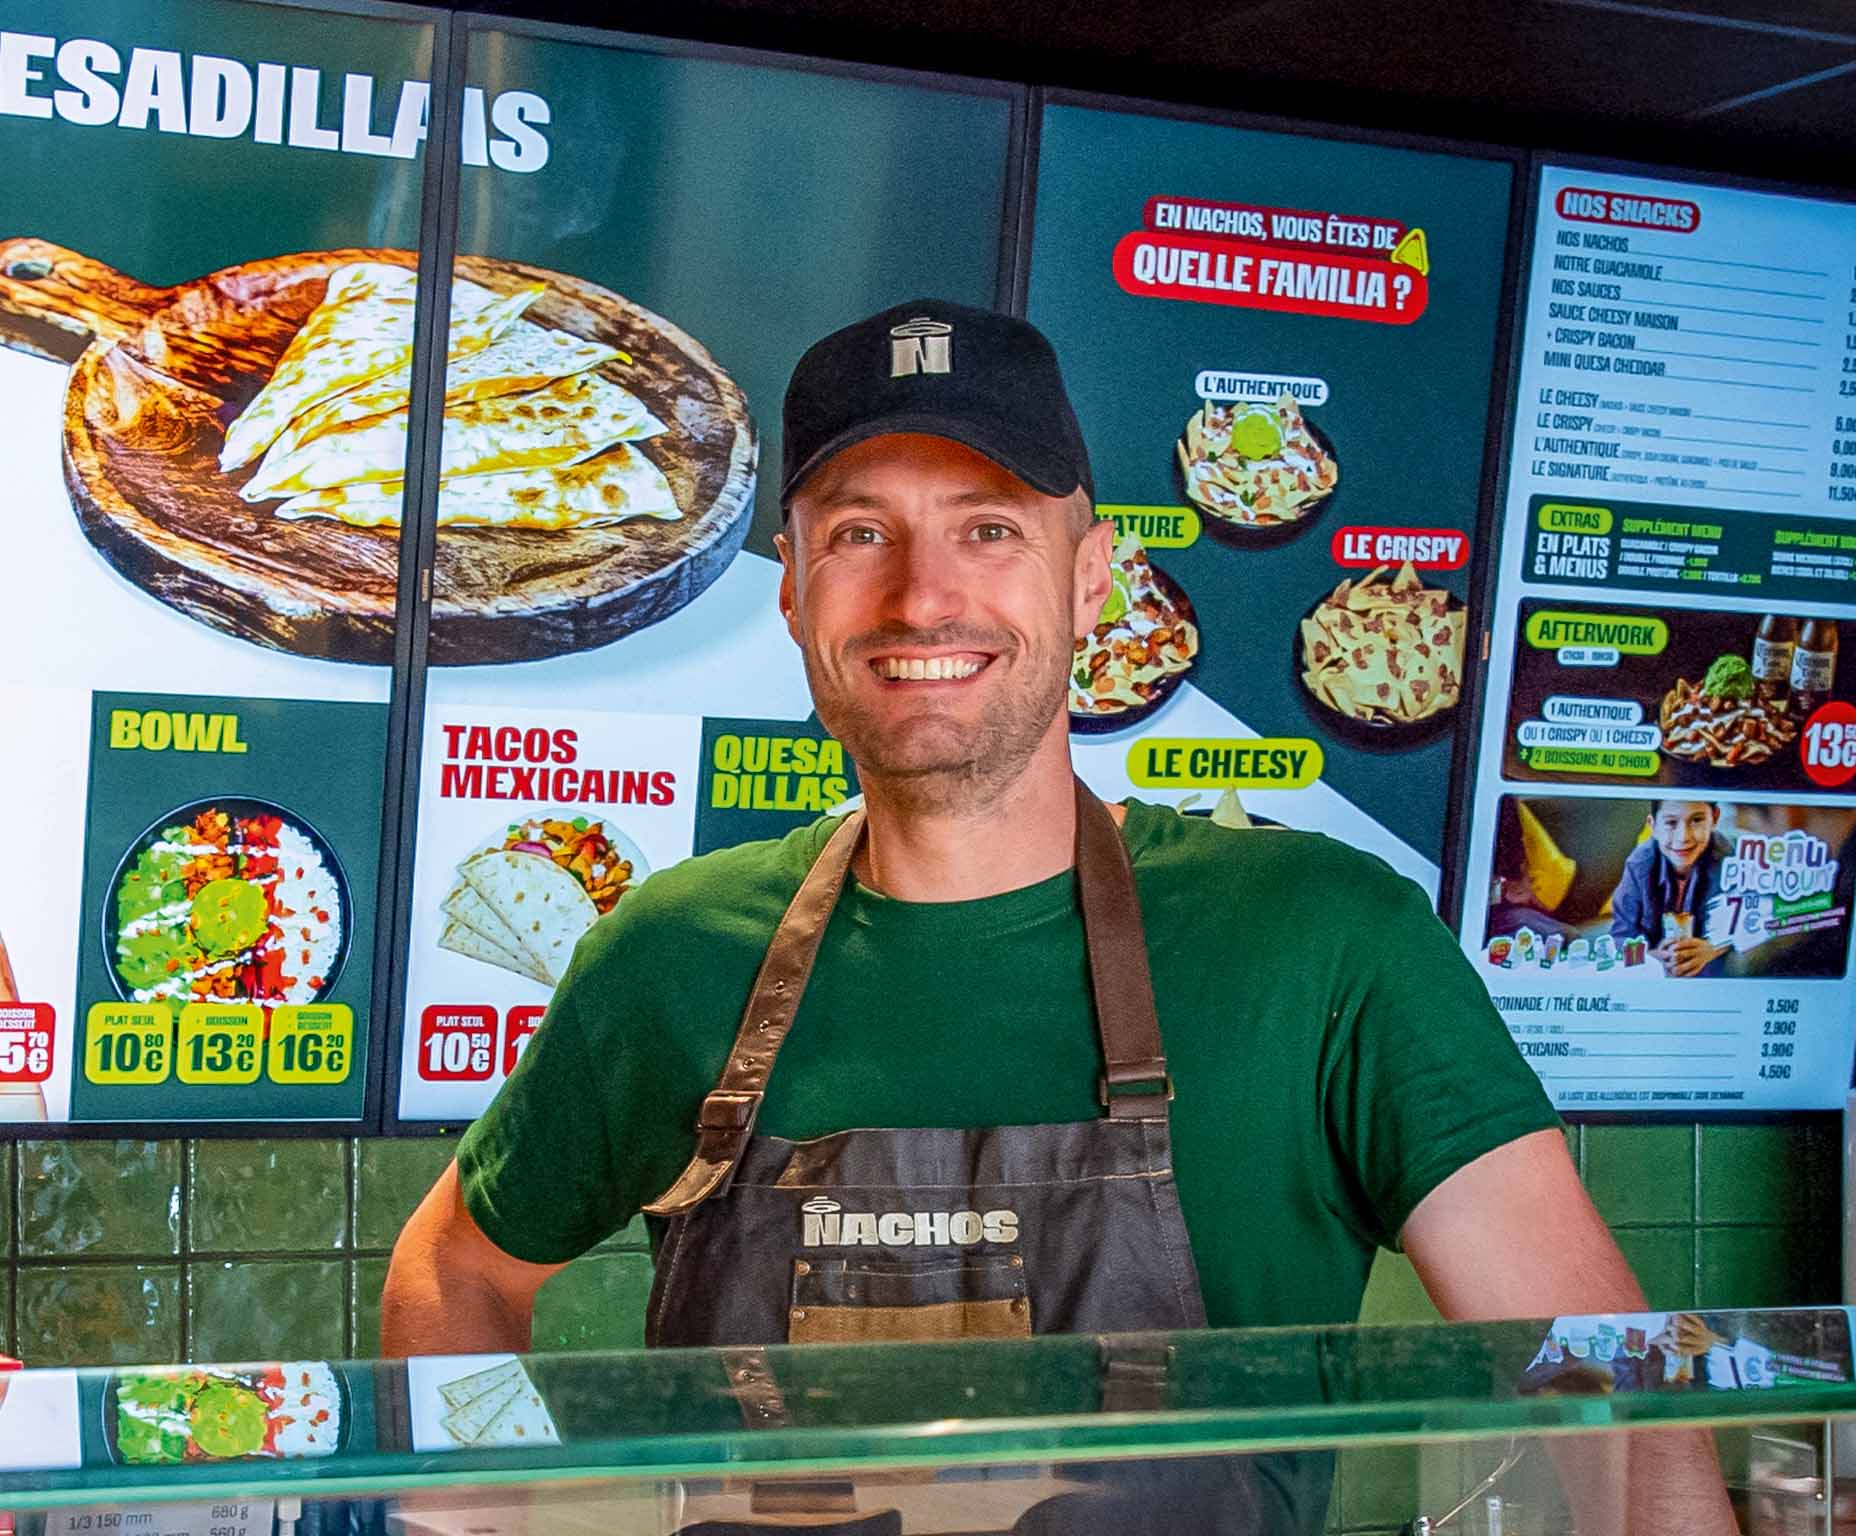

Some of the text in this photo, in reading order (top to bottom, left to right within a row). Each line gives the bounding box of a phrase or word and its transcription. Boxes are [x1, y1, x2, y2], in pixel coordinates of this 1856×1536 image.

[1563, 192, 1693, 229] NOS SNACKS
[1155, 203, 1398, 250] EN NACHOS, VOUS ÊTES DE
[1557, 230, 1629, 252] NOS NACHOS
[1133, 244, 1412, 310] QUELLE FAMILIA ?
[1554, 254, 1663, 280] NOTRE GUACAMOLE
[1552, 279, 1621, 300] NOS SAUCES
[1549, 302, 1679, 330] SAUCE CHEESY MAISON
[1555, 328, 1636, 349] CRISPY BACON
[1544, 351, 1666, 376] MINI QUESA CHEDDAR
[1204, 376, 1322, 399] L'AUTHENTIQUE
[1539, 388, 1553, 404] LE
[1555, 390, 1599, 409] CHEESY
[1536, 413, 1550, 428] LE
[1553, 414, 1594, 432] CRISPY
[1534, 437, 1620, 458] L'AUTHENTIQUE
[1531, 460, 1545, 476] LE
[1548, 461, 1610, 482] SIGNATURE
[1095, 512, 1185, 538] ATURE
[1552, 511, 1600, 529] EXTRAS
[1344, 534, 1462, 562] LE CRISPY
[1537, 532, 1559, 553] EN
[1563, 535, 1611, 557] PLATS
[1534, 555, 1546, 575] &
[1549, 555, 1608, 579] MENUS
[1538, 620, 1655, 646] AFTERWORK
[1557, 704, 1632, 720] AUTHENTIQUE
[109, 709, 248, 753] BOWL
[442, 724, 578, 764] TACOS
[1524, 726, 1655, 745] OU CRISPY OU CHEESY
[714, 734, 844, 776] QUESA
[1805, 722, 1843, 767] 13
[1147, 748, 1308, 779] LE CHEESY
[1544, 752, 1651, 768] BOISSONS AU CHOIX
[440, 763, 676, 806] MEXICAINS
[711, 776, 850, 812] DILLAS
[1727, 897, 1743, 935] 7
[1553, 994, 1574, 1011] THÉ
[1576, 994, 1610, 1012] GLACÉ
[105, 1015, 154, 1026] PLAT SEUL
[436, 1016, 484, 1027] PLAT SEUL
[94, 1033, 141, 1073] 10
[186, 1033, 233, 1073] 13
[277, 1033, 323, 1073] 16
[425, 1032, 470, 1072] 10
[69, 1516, 92, 1529] 1/3
[97, 1514, 122, 1527] 150
[126, 1513, 152, 1525] mm
[241, 1506, 248, 1520] g
